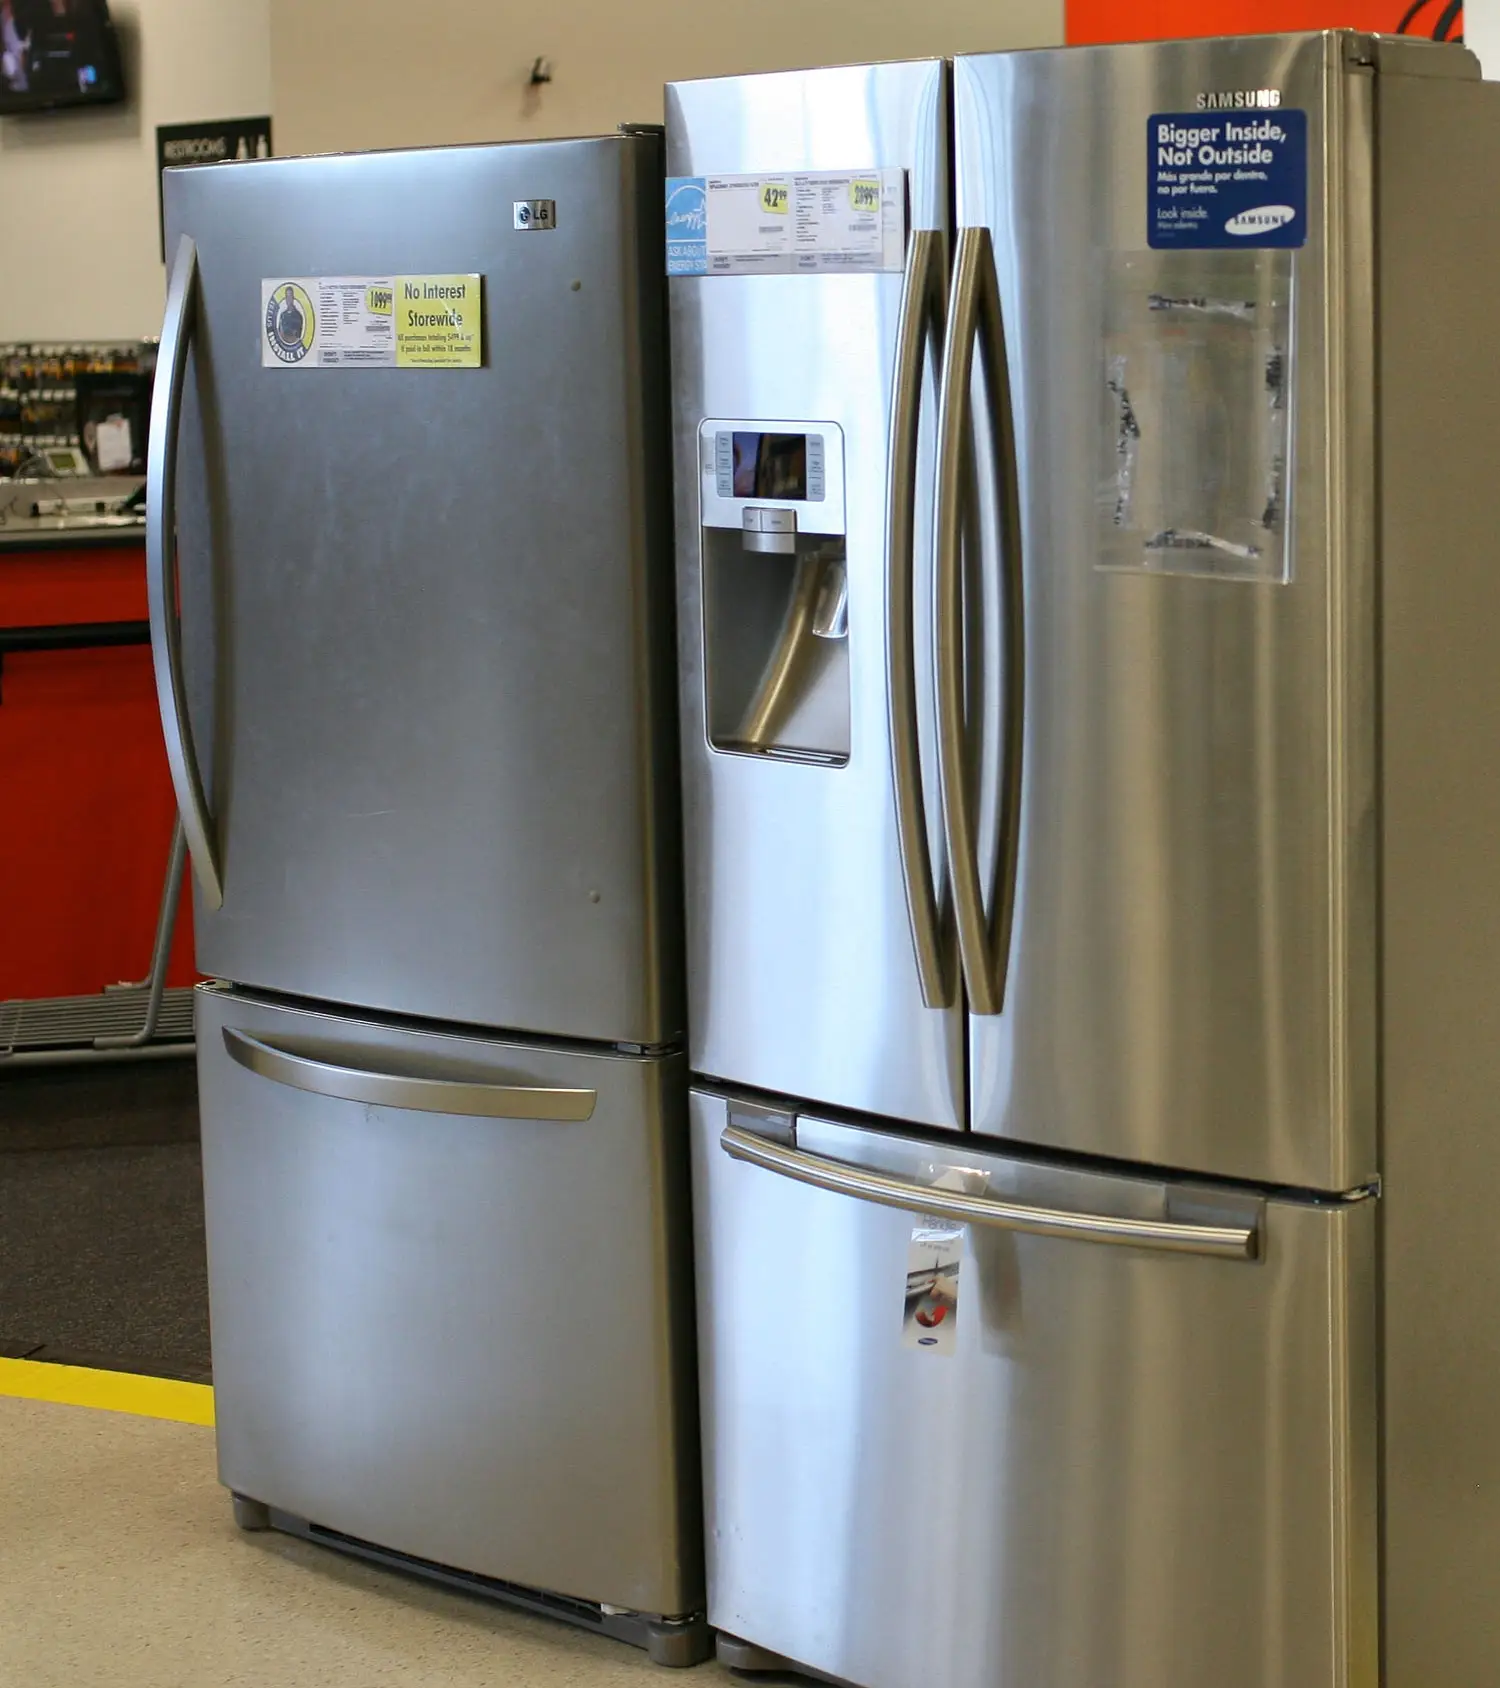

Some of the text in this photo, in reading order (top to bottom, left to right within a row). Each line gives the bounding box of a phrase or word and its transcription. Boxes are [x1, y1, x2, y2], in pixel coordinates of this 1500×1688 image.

[1196, 89, 1281, 109] SAMSUNG
[1158, 119, 1287, 148] Bigger Inside,
[1158, 143, 1274, 166] Not Outside
[1179, 169, 1213, 184] grande
[1215, 171, 1232, 183] por
[1157, 185, 1171, 194] no
[1171, 184, 1188, 197] por
[533, 209, 548, 220] LG
[1157, 206, 1178, 219] Look
[1233, 214, 1287, 227] SAMSUNG
[404, 282, 466, 299] No Interest
[408, 308, 463, 327] Storewide
